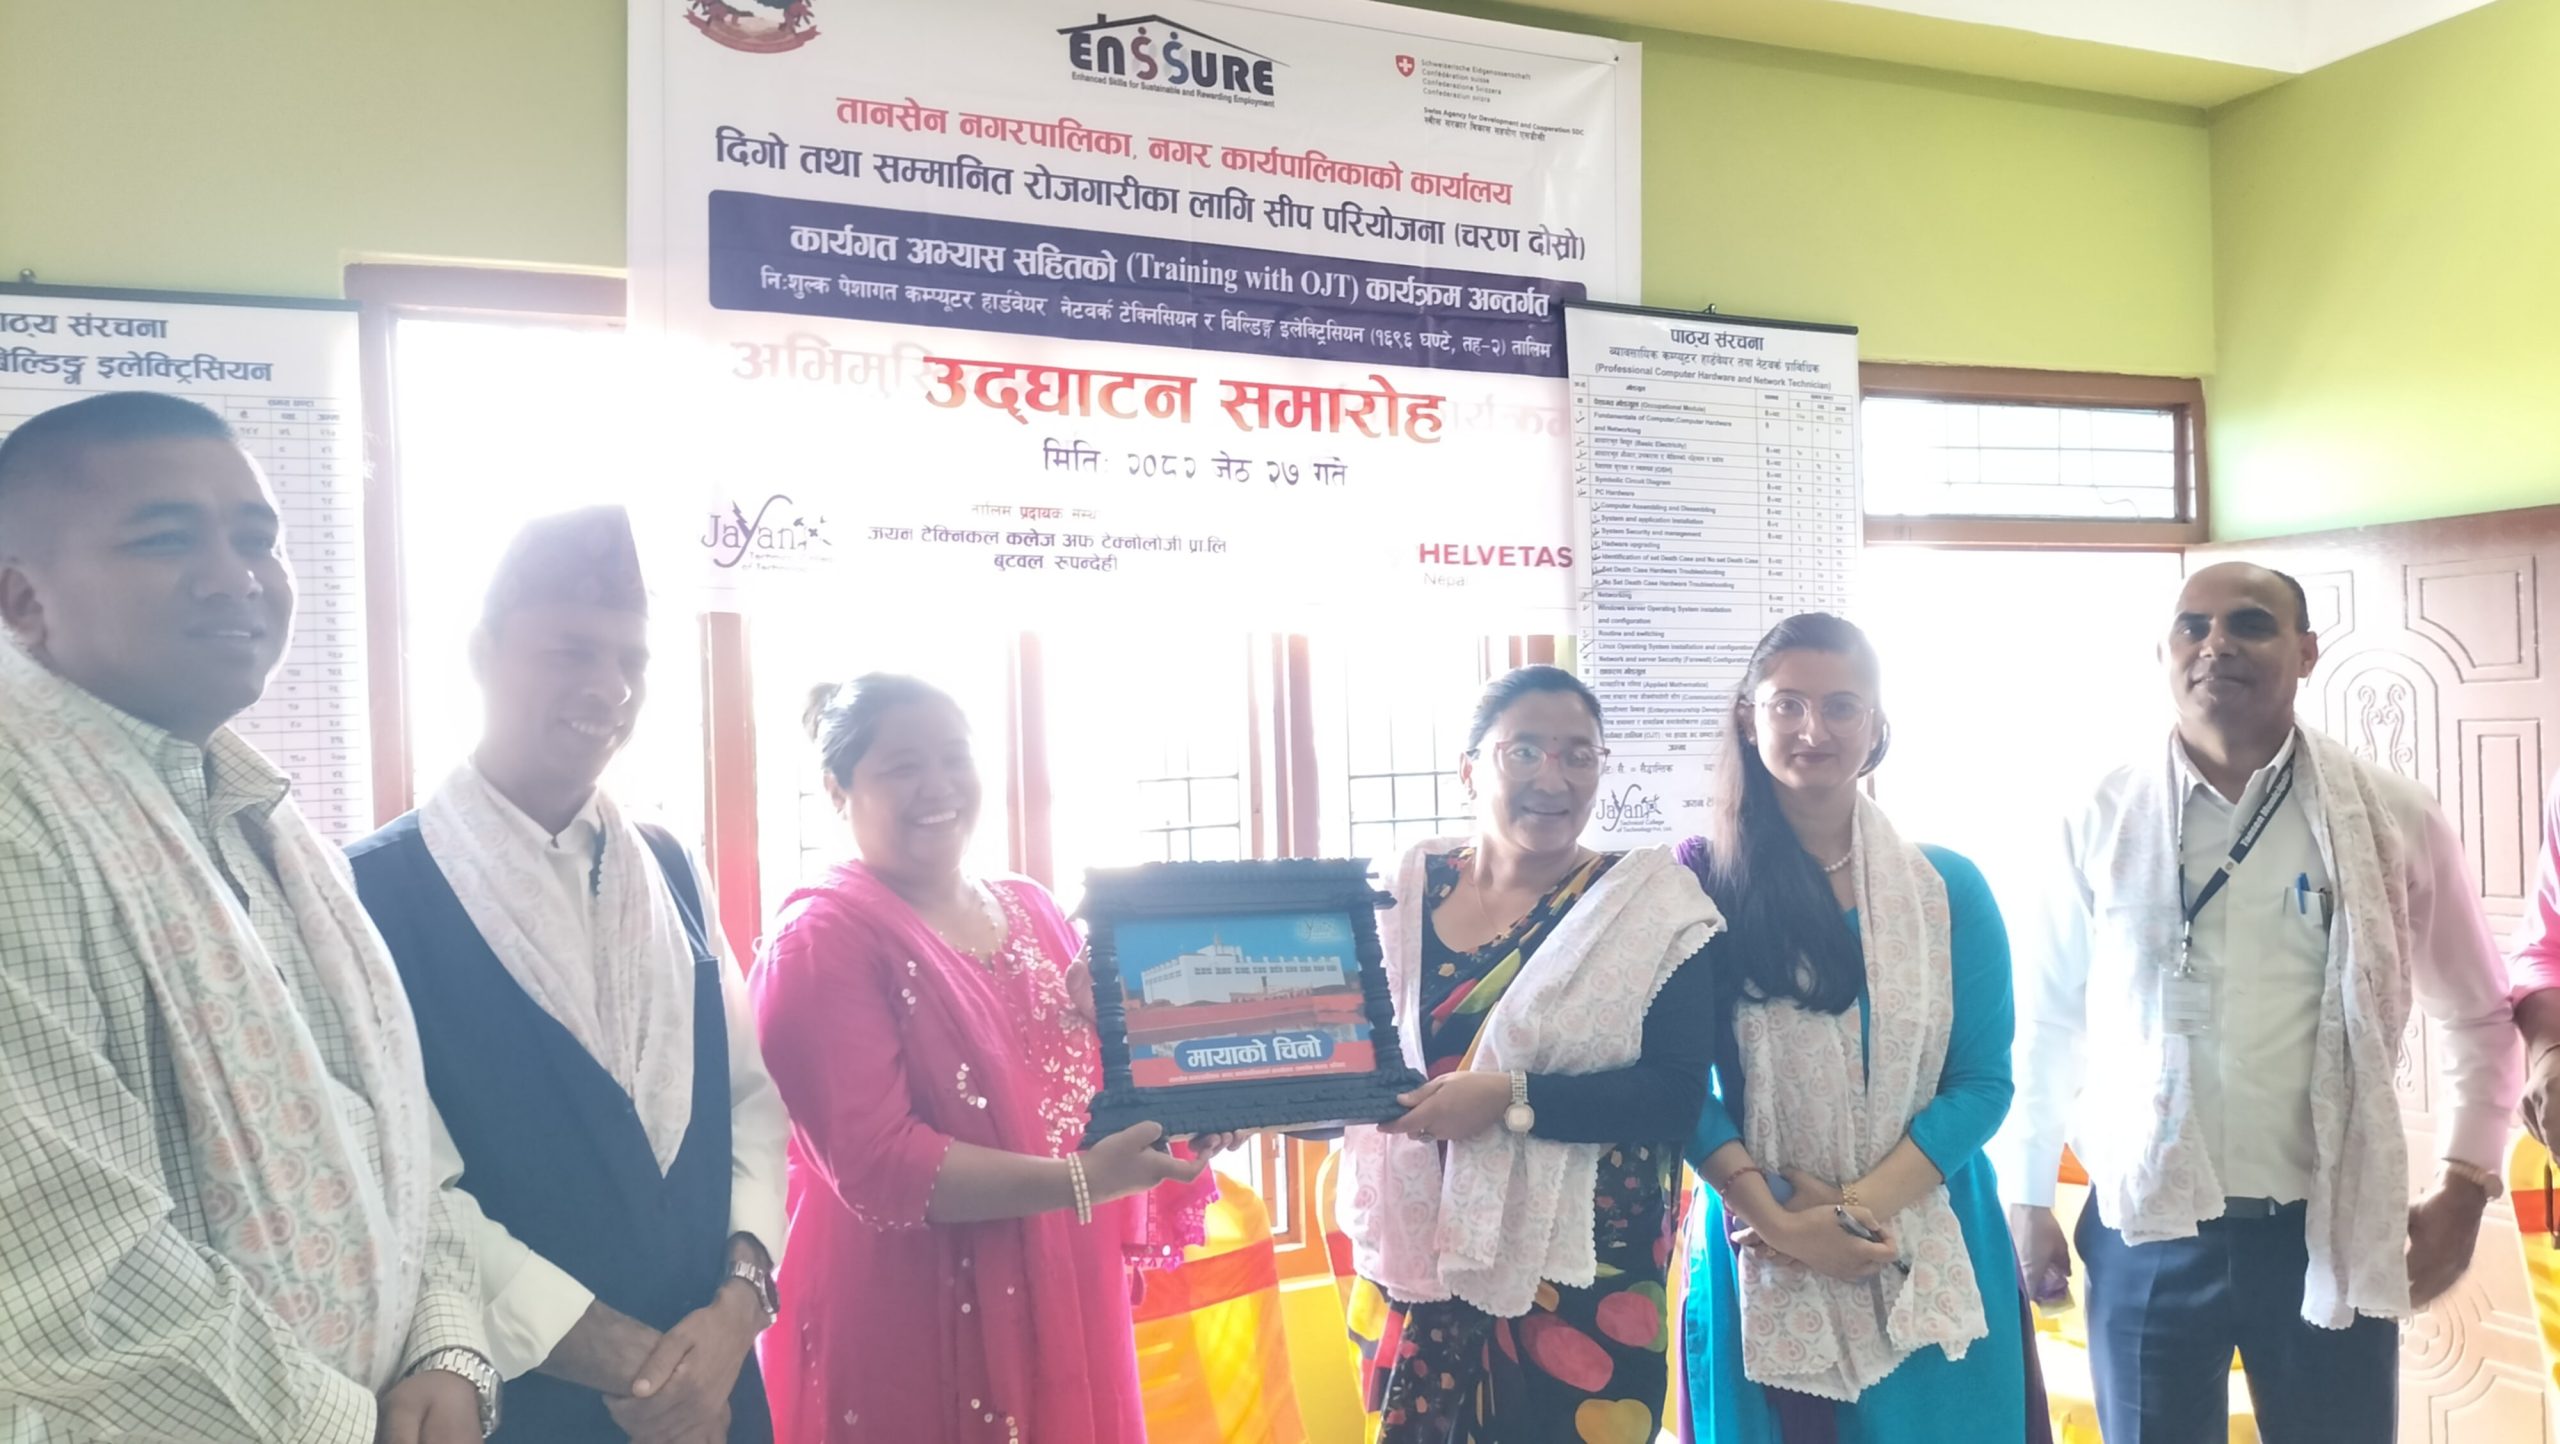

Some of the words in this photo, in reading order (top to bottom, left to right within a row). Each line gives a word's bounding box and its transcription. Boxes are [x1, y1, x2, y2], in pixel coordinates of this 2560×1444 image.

[1071, 71, 1107, 85] Enhanced
[1108, 74, 1128, 88] Skills
[1129, 79, 1139, 89] for
[1140, 80, 1181, 96] Sustainable
[1182, 88, 1195, 98] and
[1196, 89, 1232, 104] Rewarding
[1233, 95, 1275, 108] Employment
[1423, 106, 1442, 115] Swiss
[1443, 109, 1467, 120] Agency
[1467, 112, 1478, 120] for
[1479, 114, 1520, 129] Development
[1520, 120, 1532, 129] and
[1532, 123, 1571, 135] Cooperation
[1572, 127, 1585, 136] SDC
[836, 97, 947, 135] तानसेन
[958, 111, 1138, 161] नगरपालिका,
[1148, 137, 1212, 169] नगर
[1220, 145, 1402, 193] कार्यपालिकाको
[1410, 171, 1513, 206] कार्यालय
[715, 125, 788, 171] दिगो
[799, 144, 862, 179] तथा
[872, 152, 1014, 197] सम्मानित
[1022, 163, 1179, 215] रोजगारीका
[1188, 186, 1255, 224] लागि
[1263, 196, 1315, 231] सीप
[1323, 200, 1445, 246] परियोजना
[1454, 221, 1520, 254] (चरण
[789, 223, 899, 263] कार्यगत
[906, 237, 1006, 273] अभ्यास
[1013, 242, 1118, 283] सहितको
[1126, 251, 1239, 294] (Training
[1244, 264, 1294, 294] with
[1300, 270, 1359, 305] OJT)
[1366, 276, 1462, 314] कार्यक्रम
[1467, 288, 1551, 317] अन्तर्गत
[0, 312, 58, 338] ाठ्य
[67, 312, 169, 339] संरचना
[838, 273, 898, 302] पेशागत
[904, 284, 974, 314] कम्प्यूटर
[981, 289, 1048, 317] हार्डवेयर
[1060, 295, 1114, 320] नेटवर्क
[1119, 301, 1198, 329] टेक्निसियन
[1203, 314, 1215, 332] र
[1279, 316, 1365, 345] इलेक्ट्रिसियन
[1370, 327, 1412, 350] (१६९६
[1511, 335, 1552, 359] तालिम
[1670, 328, 1710, 349] पाठ्य
[1715, 331, 1765, 351] संरचना
[97, 351, 273, 384] इलेक्ट्रिसियन
[1595, 362, 1653, 377] (Professional
[1655, 367, 1696, 380] Computer
[1698, 371, 1736, 384] Hardware
[1738, 375, 1752, 385] and
[1753, 376, 1786, 388] Network
[1788, 377, 1832, 391] Technician)
[1219, 373, 1447, 443] समारोह
[1211, 450, 1253, 485] जेठ
[1266, 459, 1300, 486] २७
[1313, 456, 1349, 487] गते
[920, 524, 1000, 547] टेक्निकल
[1006, 527, 1056, 548] कलेज
[1101, 531, 1182, 552] टेक्नोलोजी
[993, 553, 1044, 573] बुटवल
[1418, 542, 1574, 569] HELVETAS
[1186, 1038, 1268, 1069] मायाको
[1273, 1034, 1323, 1062] चिनो
